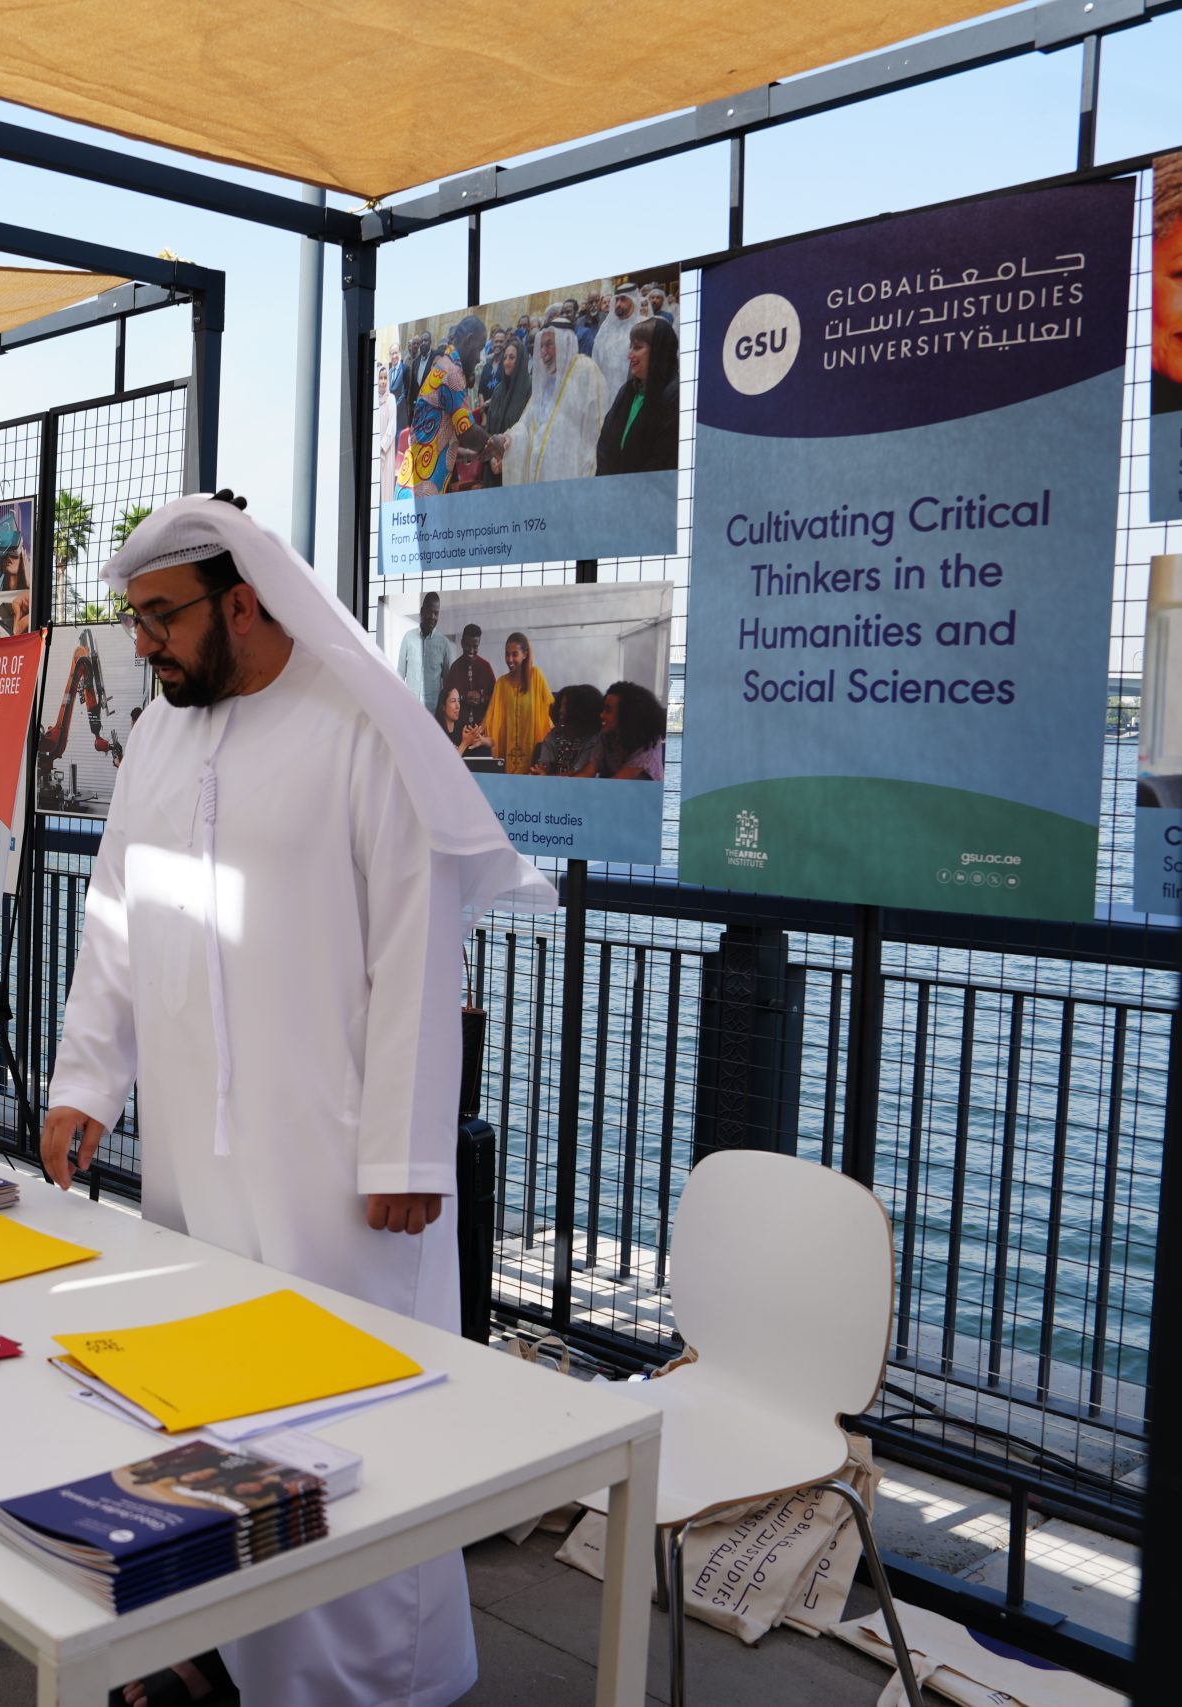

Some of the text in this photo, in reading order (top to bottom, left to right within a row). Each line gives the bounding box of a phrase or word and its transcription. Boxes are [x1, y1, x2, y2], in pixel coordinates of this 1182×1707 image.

[929, 253, 1085, 291] جامعة
[827, 274, 925, 309] GLOBAL
[962, 283, 1084, 318] STUDIES
[735, 326, 788, 360] GSU
[823, 329, 974, 370] UNIVERSITY
[391, 518, 547, 545] From Afro-Arab symposium in 1976
[392, 512, 427, 527] History
[726, 490, 1051, 547] Cultivating Critical
[391, 554, 399, 563] to
[408, 548, 466, 565] postgraduate
[469, 542, 513, 557] university
[751, 553, 1003, 597] Thinkers in the
[738, 610, 1017, 650] Humanities and
[10, 655, 24, 674] OF
[743, 668, 1016, 705] Social Sciences
[508, 810, 541, 826] global
[544, 814, 583, 826] studies
[508, 830, 574, 847] and beyond
[728, 857, 765, 868] INSTITUTE
[961, 852, 1021, 865] gsu.ac.ae
[712, 1547, 759, 1607] STUDIES
